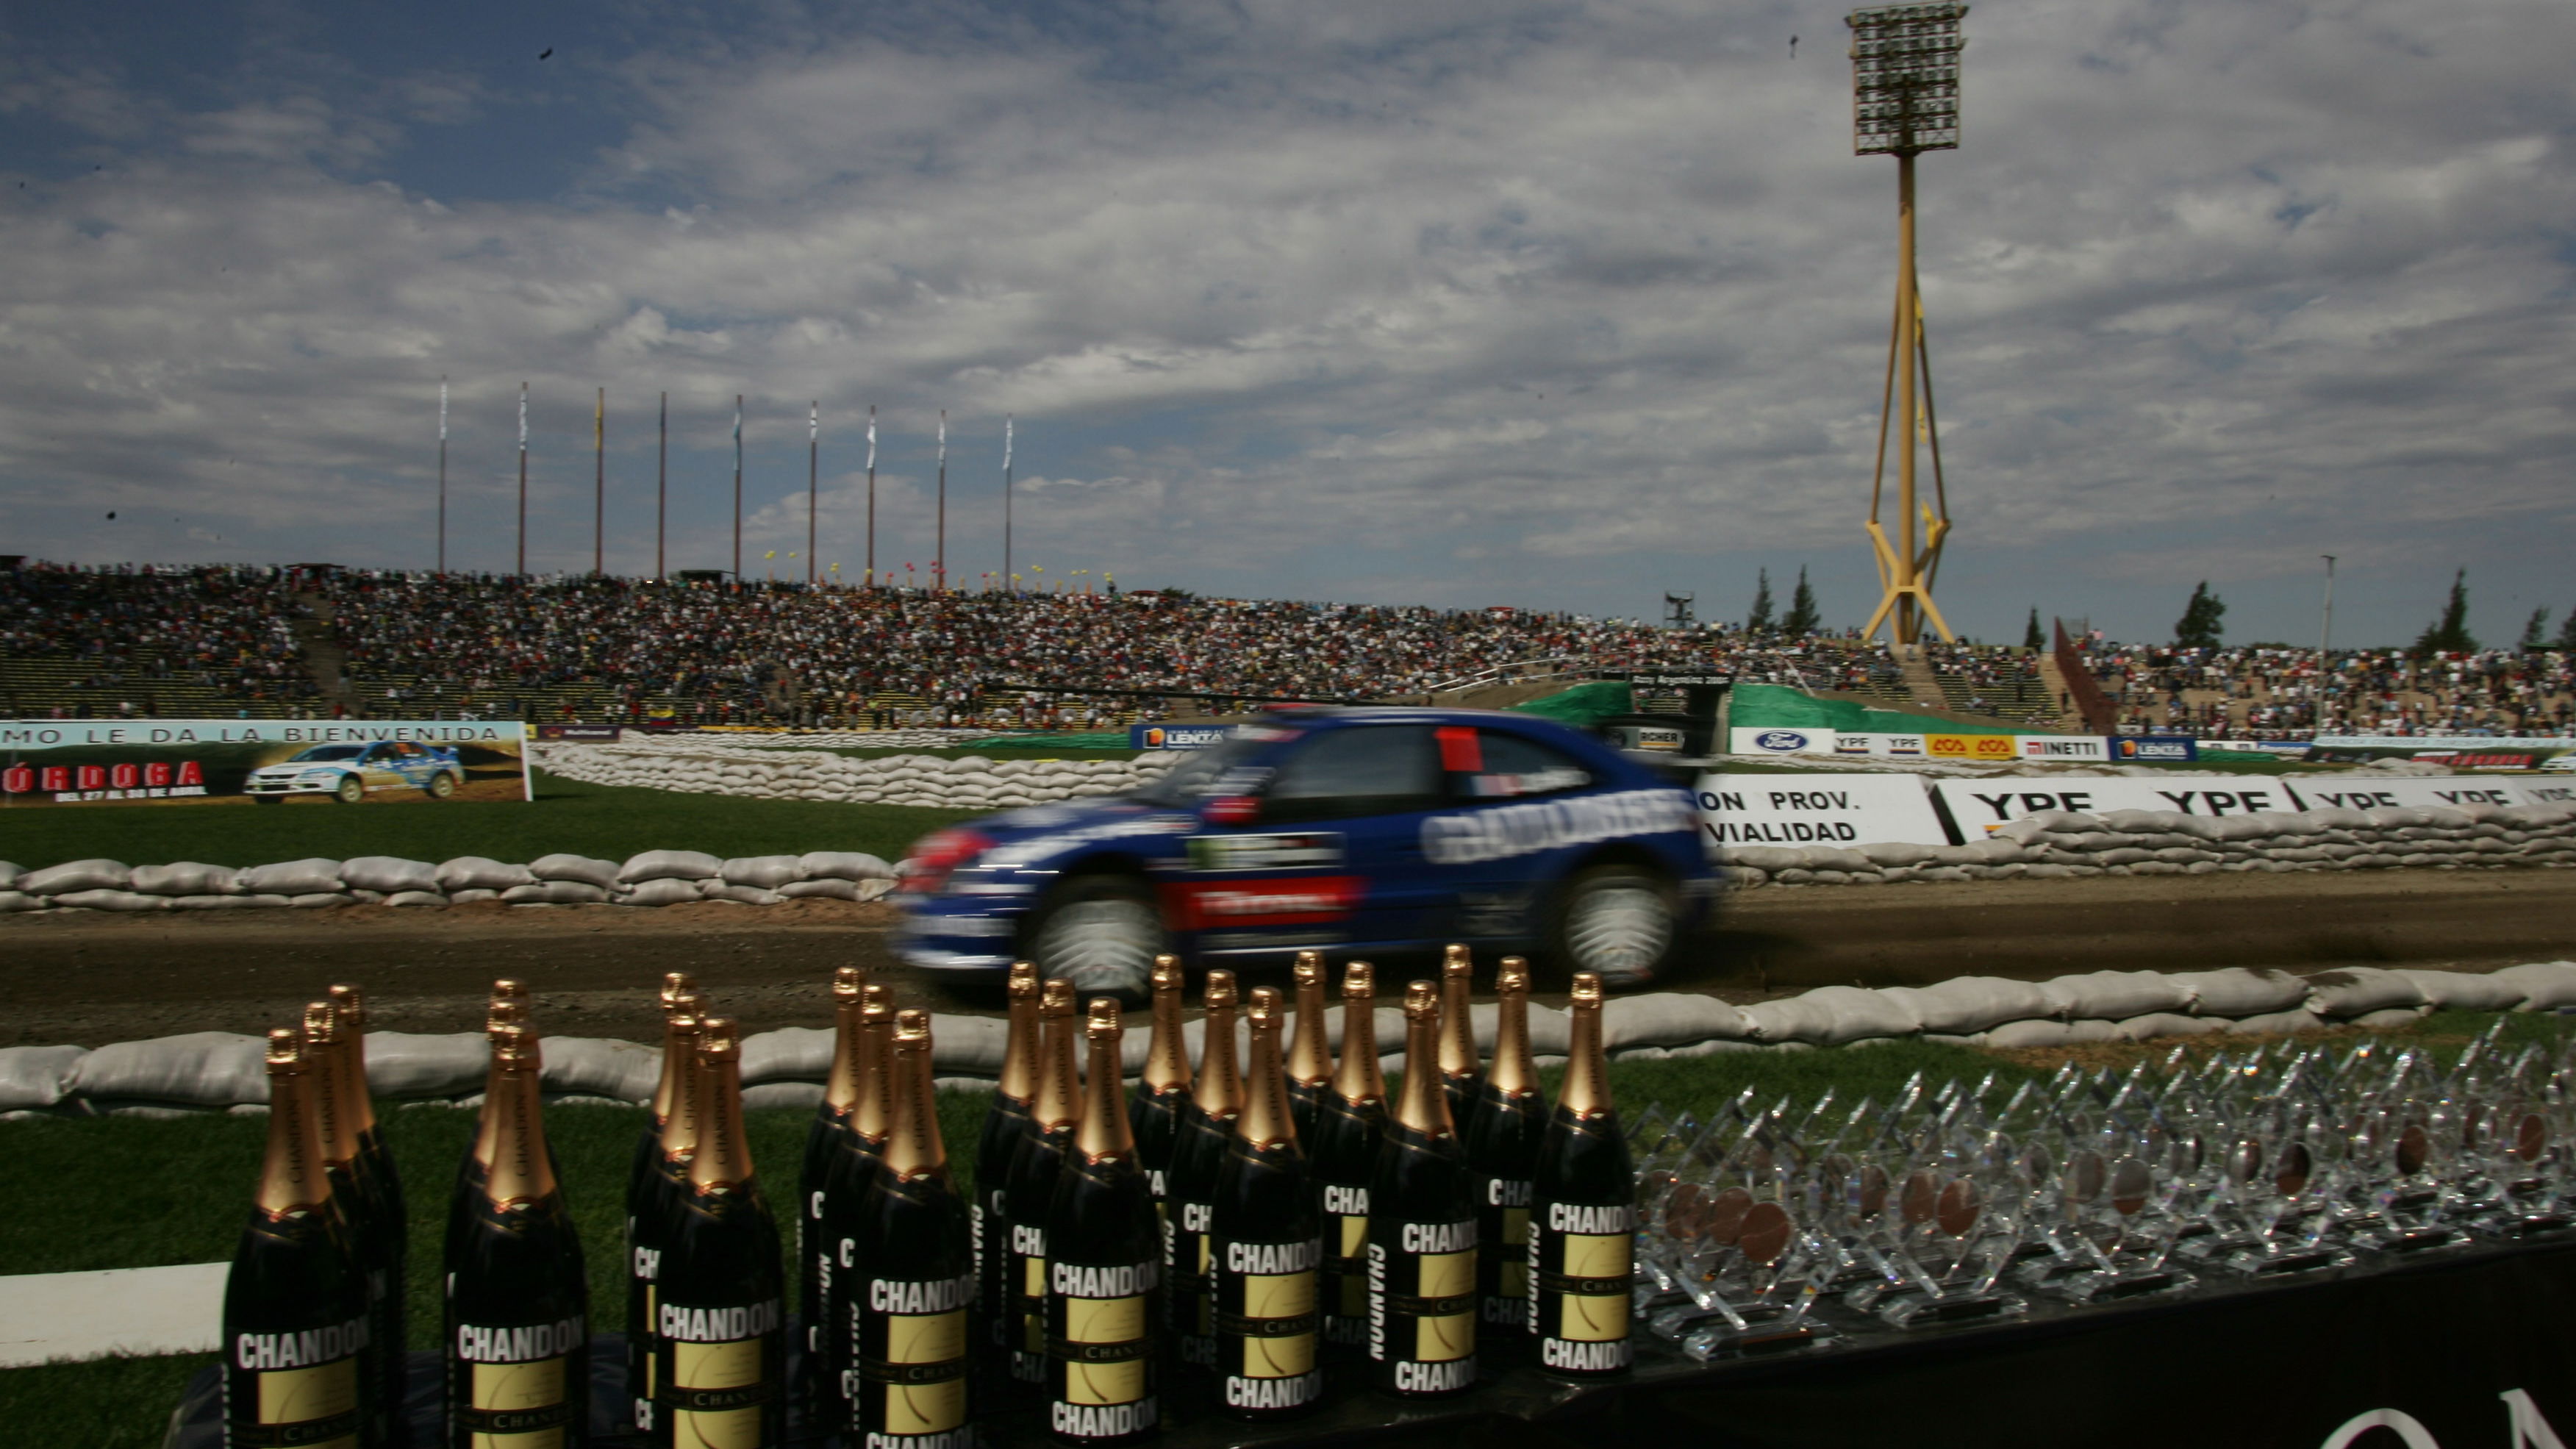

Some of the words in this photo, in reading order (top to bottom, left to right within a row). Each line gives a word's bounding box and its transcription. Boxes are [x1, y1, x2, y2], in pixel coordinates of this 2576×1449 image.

[88, 729, 125, 744] LE
[151, 729, 198, 743] DA
[222, 729, 261, 743] LA
[285, 728, 500, 742] BIENVENIDA
[1167, 734, 1223, 744] LENTA
[1765, 732, 1800, 748] Ford
[1837, 737, 1870, 748] YPF
[1890, 738, 1920, 748] YPF
[1768, 791, 1861, 810] PROV.
[1705, 822, 1856, 842] VIALIDAD
[716, 1084, 731, 1164] CHANDON
[1367, 1242, 1386, 1361] CHANDON
